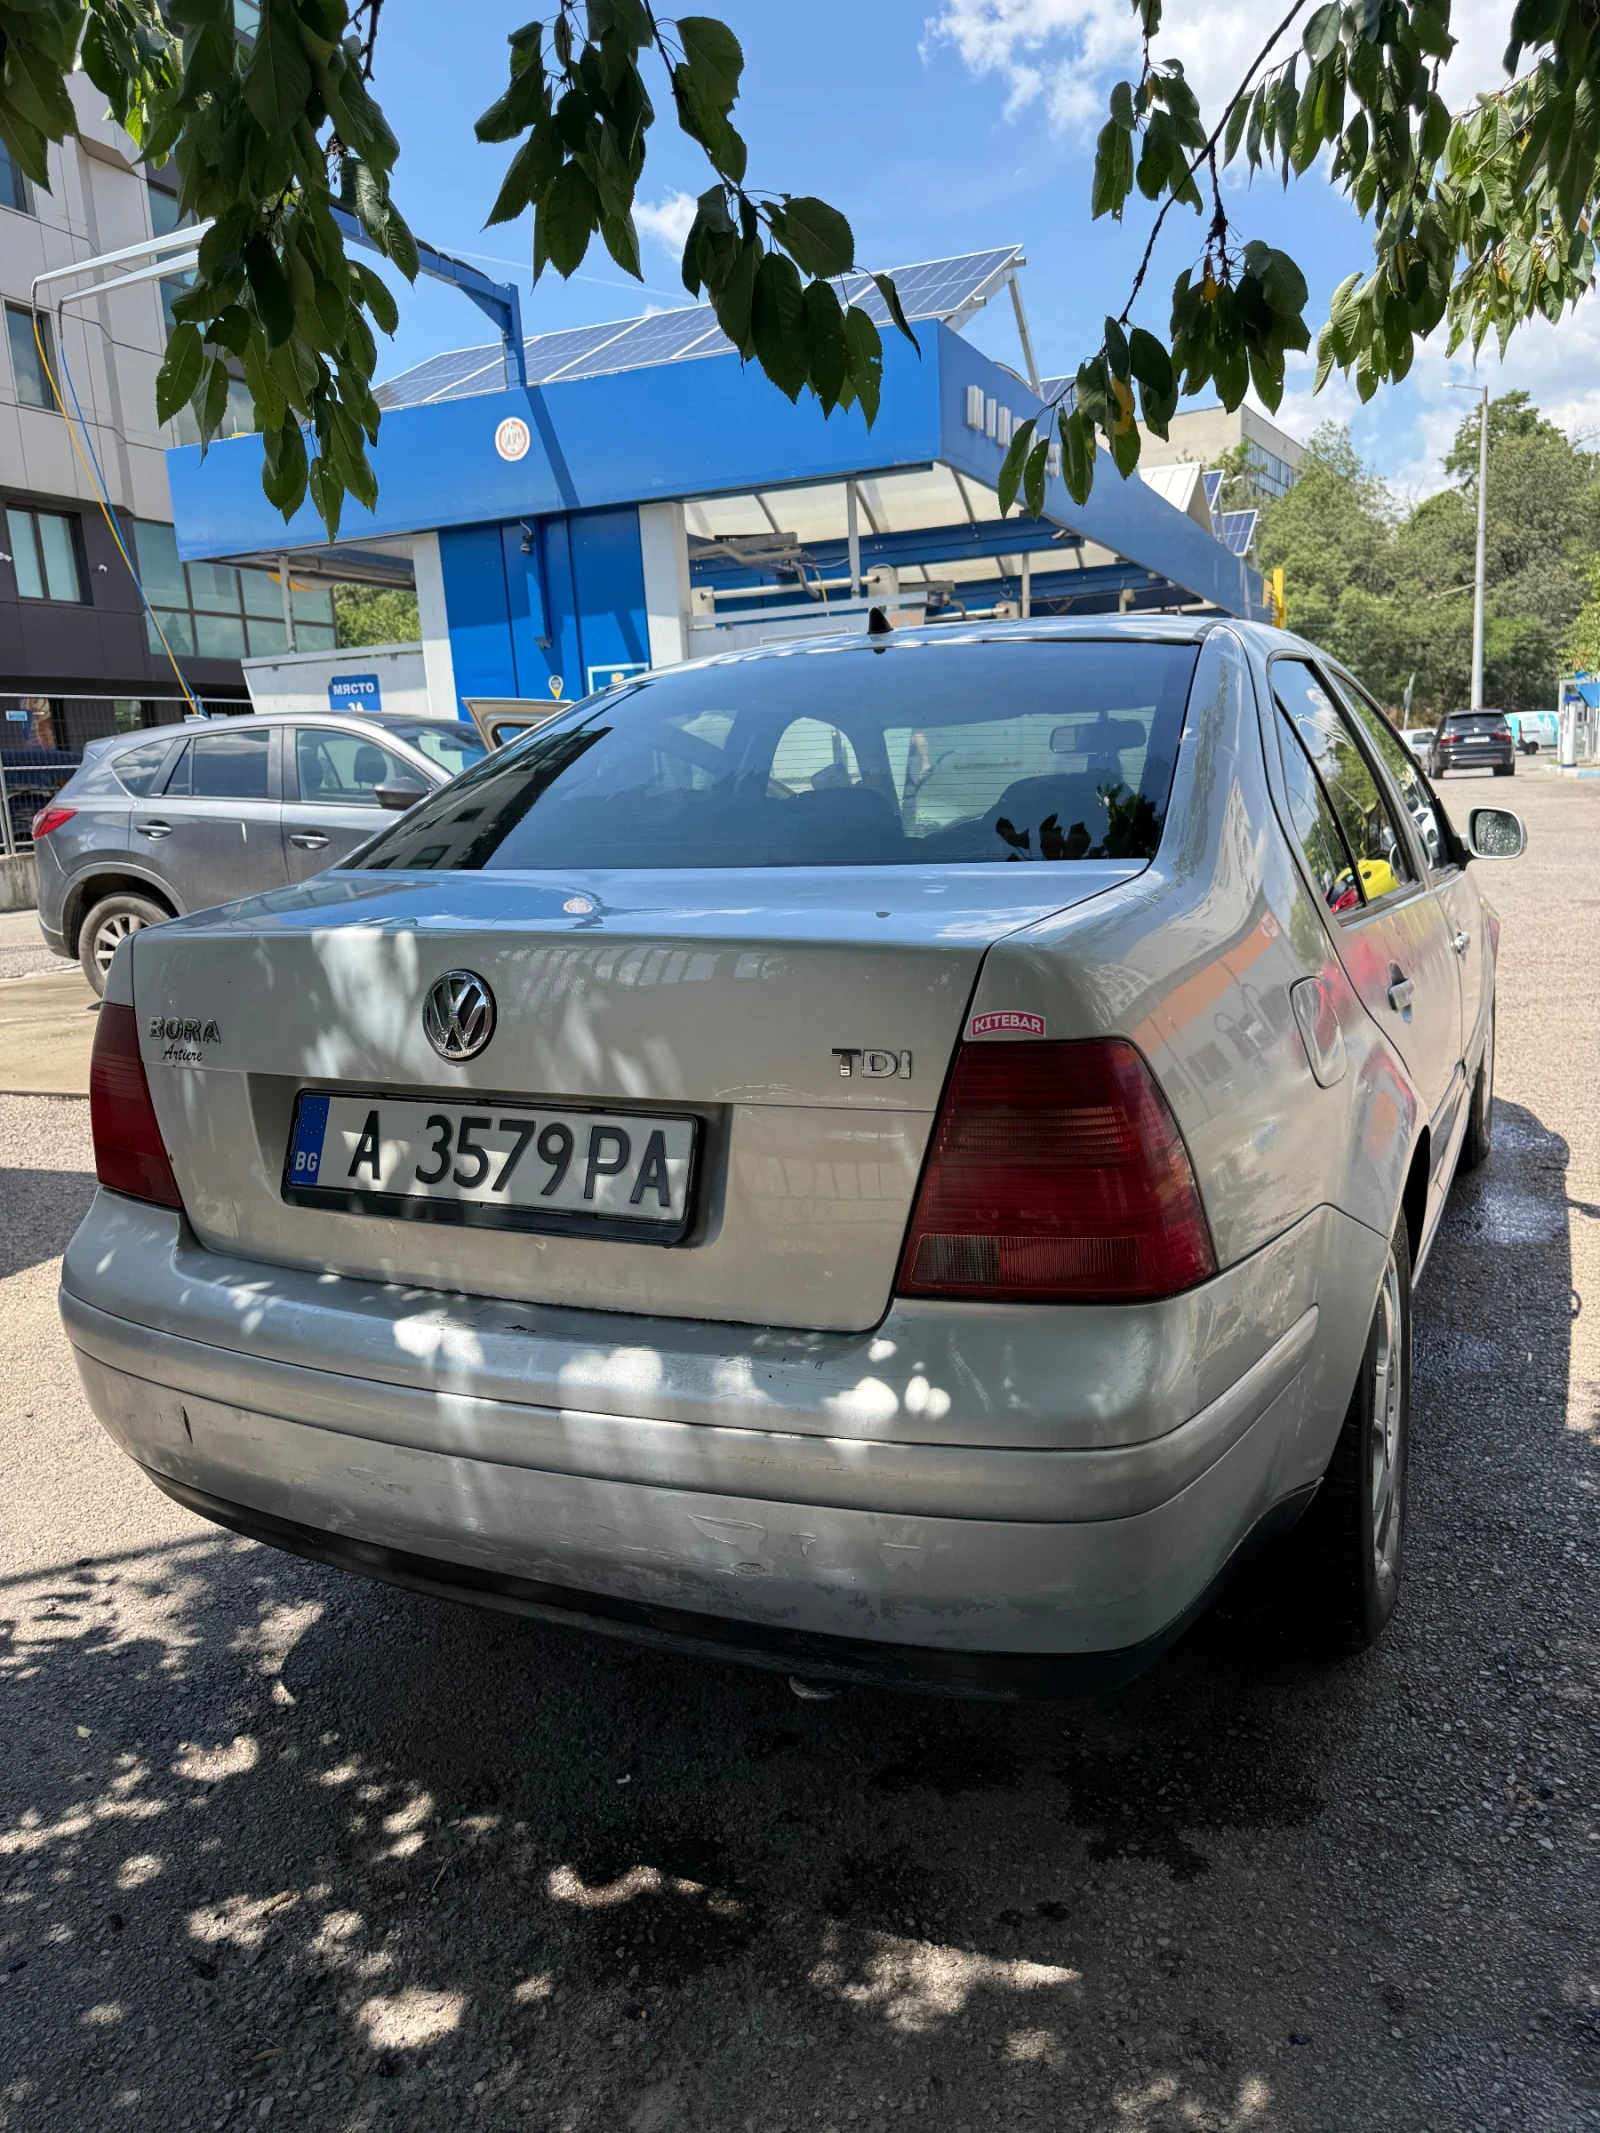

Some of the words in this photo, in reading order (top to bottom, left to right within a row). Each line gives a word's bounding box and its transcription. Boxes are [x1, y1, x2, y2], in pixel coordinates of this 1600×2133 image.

[333, 682, 375, 696] МЯСТО
[148, 1016, 222, 1044] BORA
[974, 1014, 1042, 1033] KITEBAR
[162, 1043, 203, 1062] Artiere
[831, 1048, 912, 1080] TDI
[294, 1151, 318, 1173] BG
